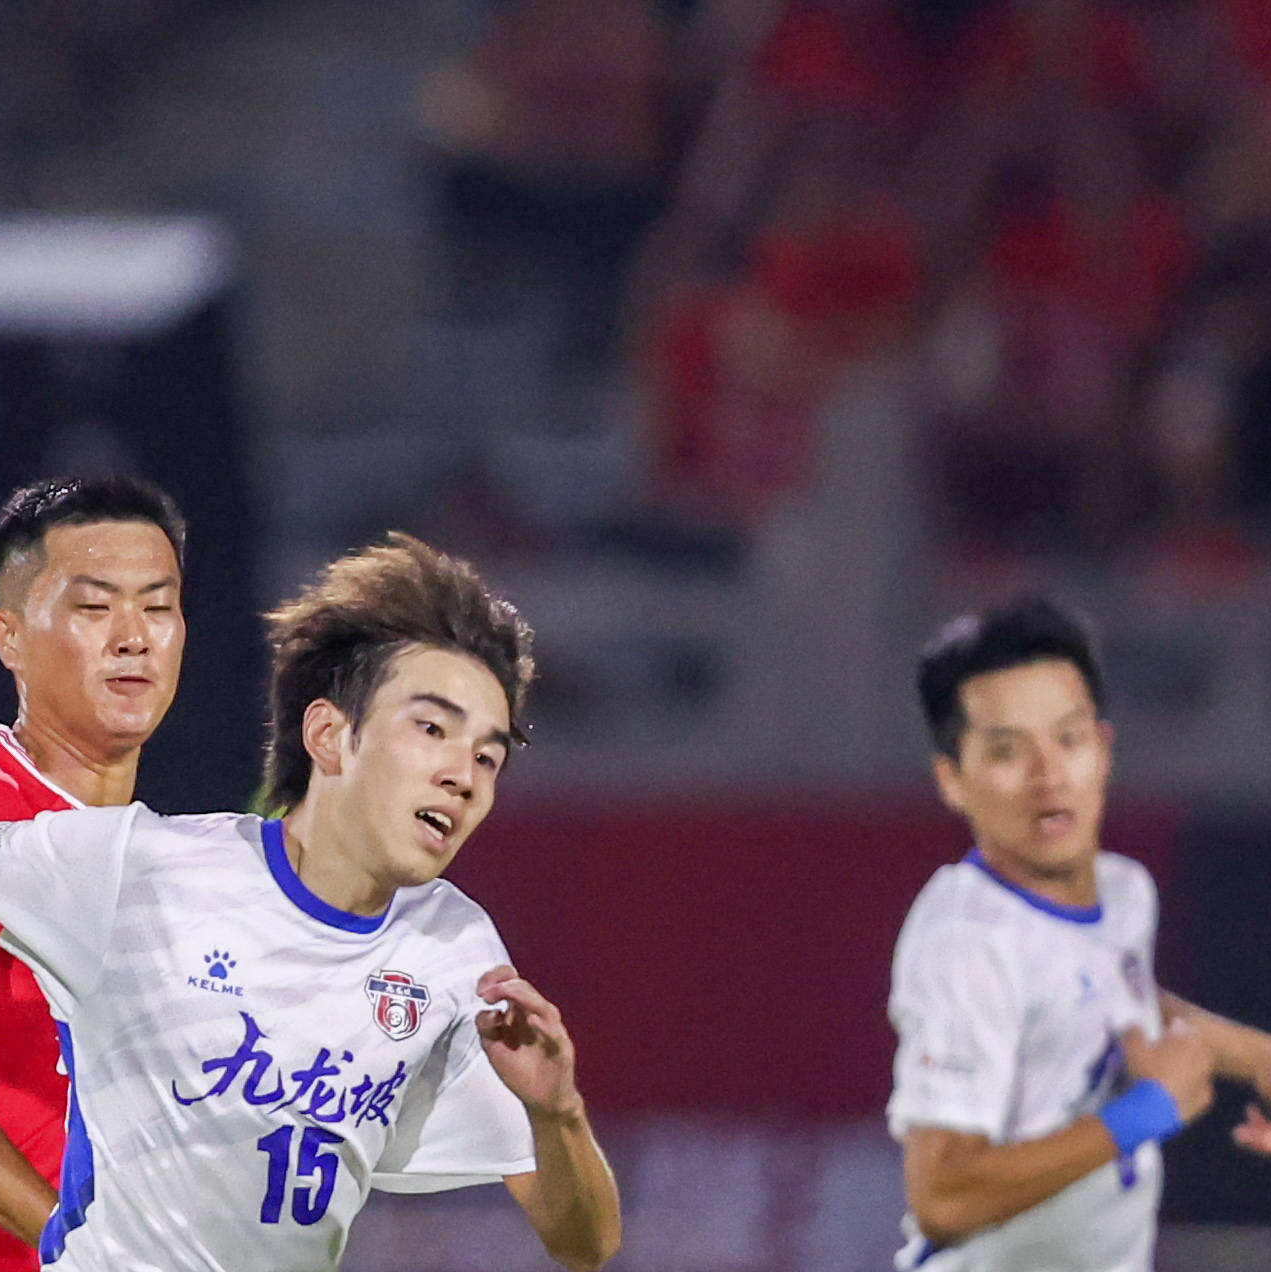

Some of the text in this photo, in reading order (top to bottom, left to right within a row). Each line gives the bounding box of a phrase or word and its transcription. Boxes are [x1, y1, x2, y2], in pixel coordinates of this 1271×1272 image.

[187, 975, 244, 997] KELME
[172, 1010, 407, 1128] 九龙坡
[256, 1124, 346, 1226] 15
